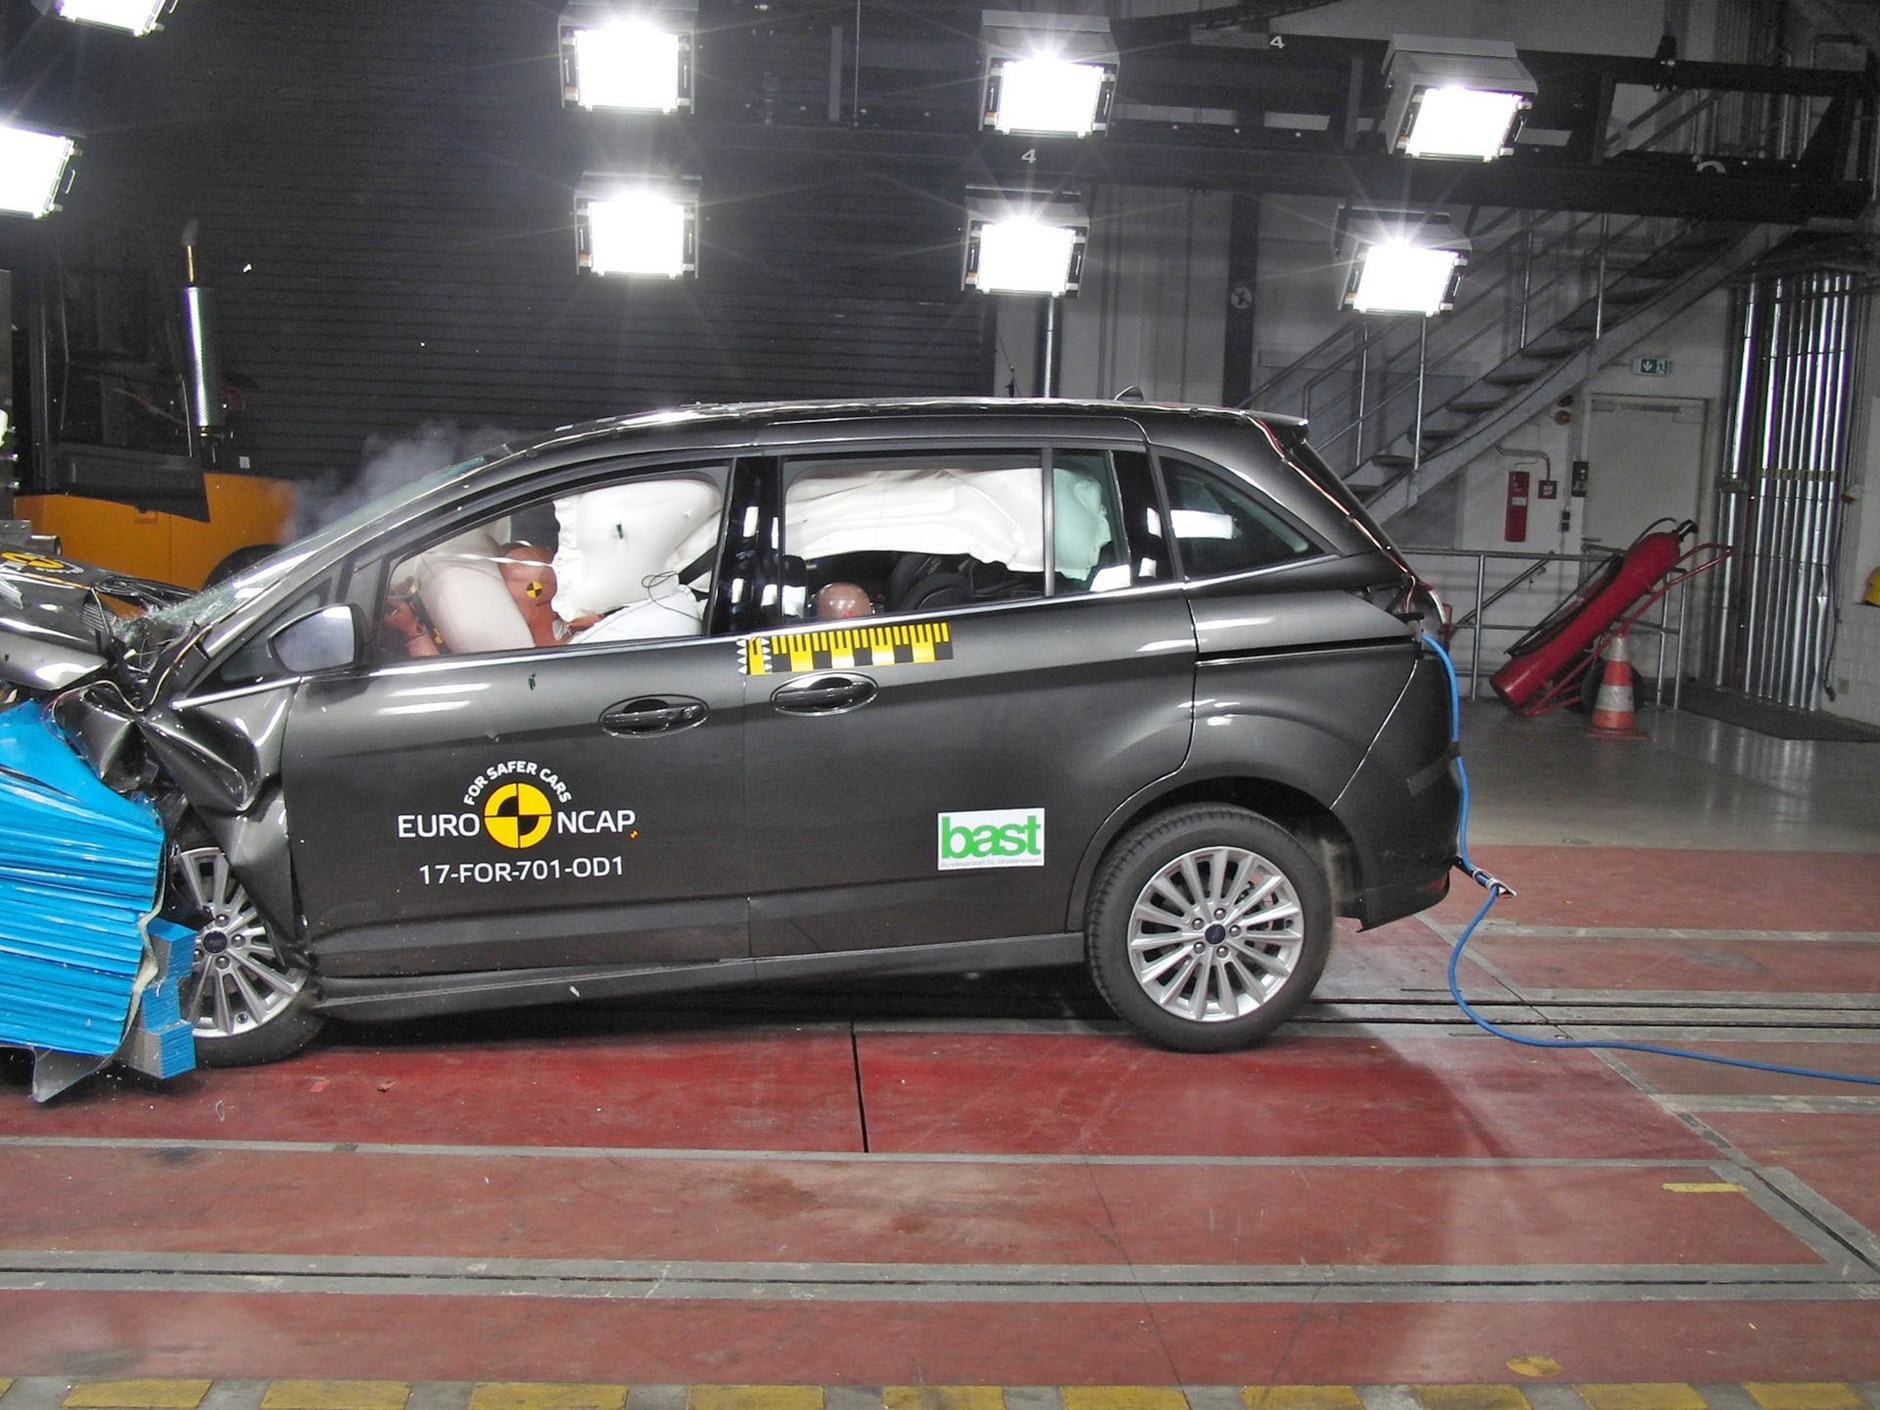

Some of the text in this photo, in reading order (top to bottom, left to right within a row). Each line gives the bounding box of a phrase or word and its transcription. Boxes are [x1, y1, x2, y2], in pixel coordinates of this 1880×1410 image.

[1269, 35, 1285, 49] 4
[1021, 148, 1037, 164] 4
[463, 760, 572, 806] FOR SAFER CARS
[397, 809, 637, 838] EURO NCAP
[941, 815, 1042, 859] bast
[419, 855, 623, 885] 17-FOR-701-OD1
